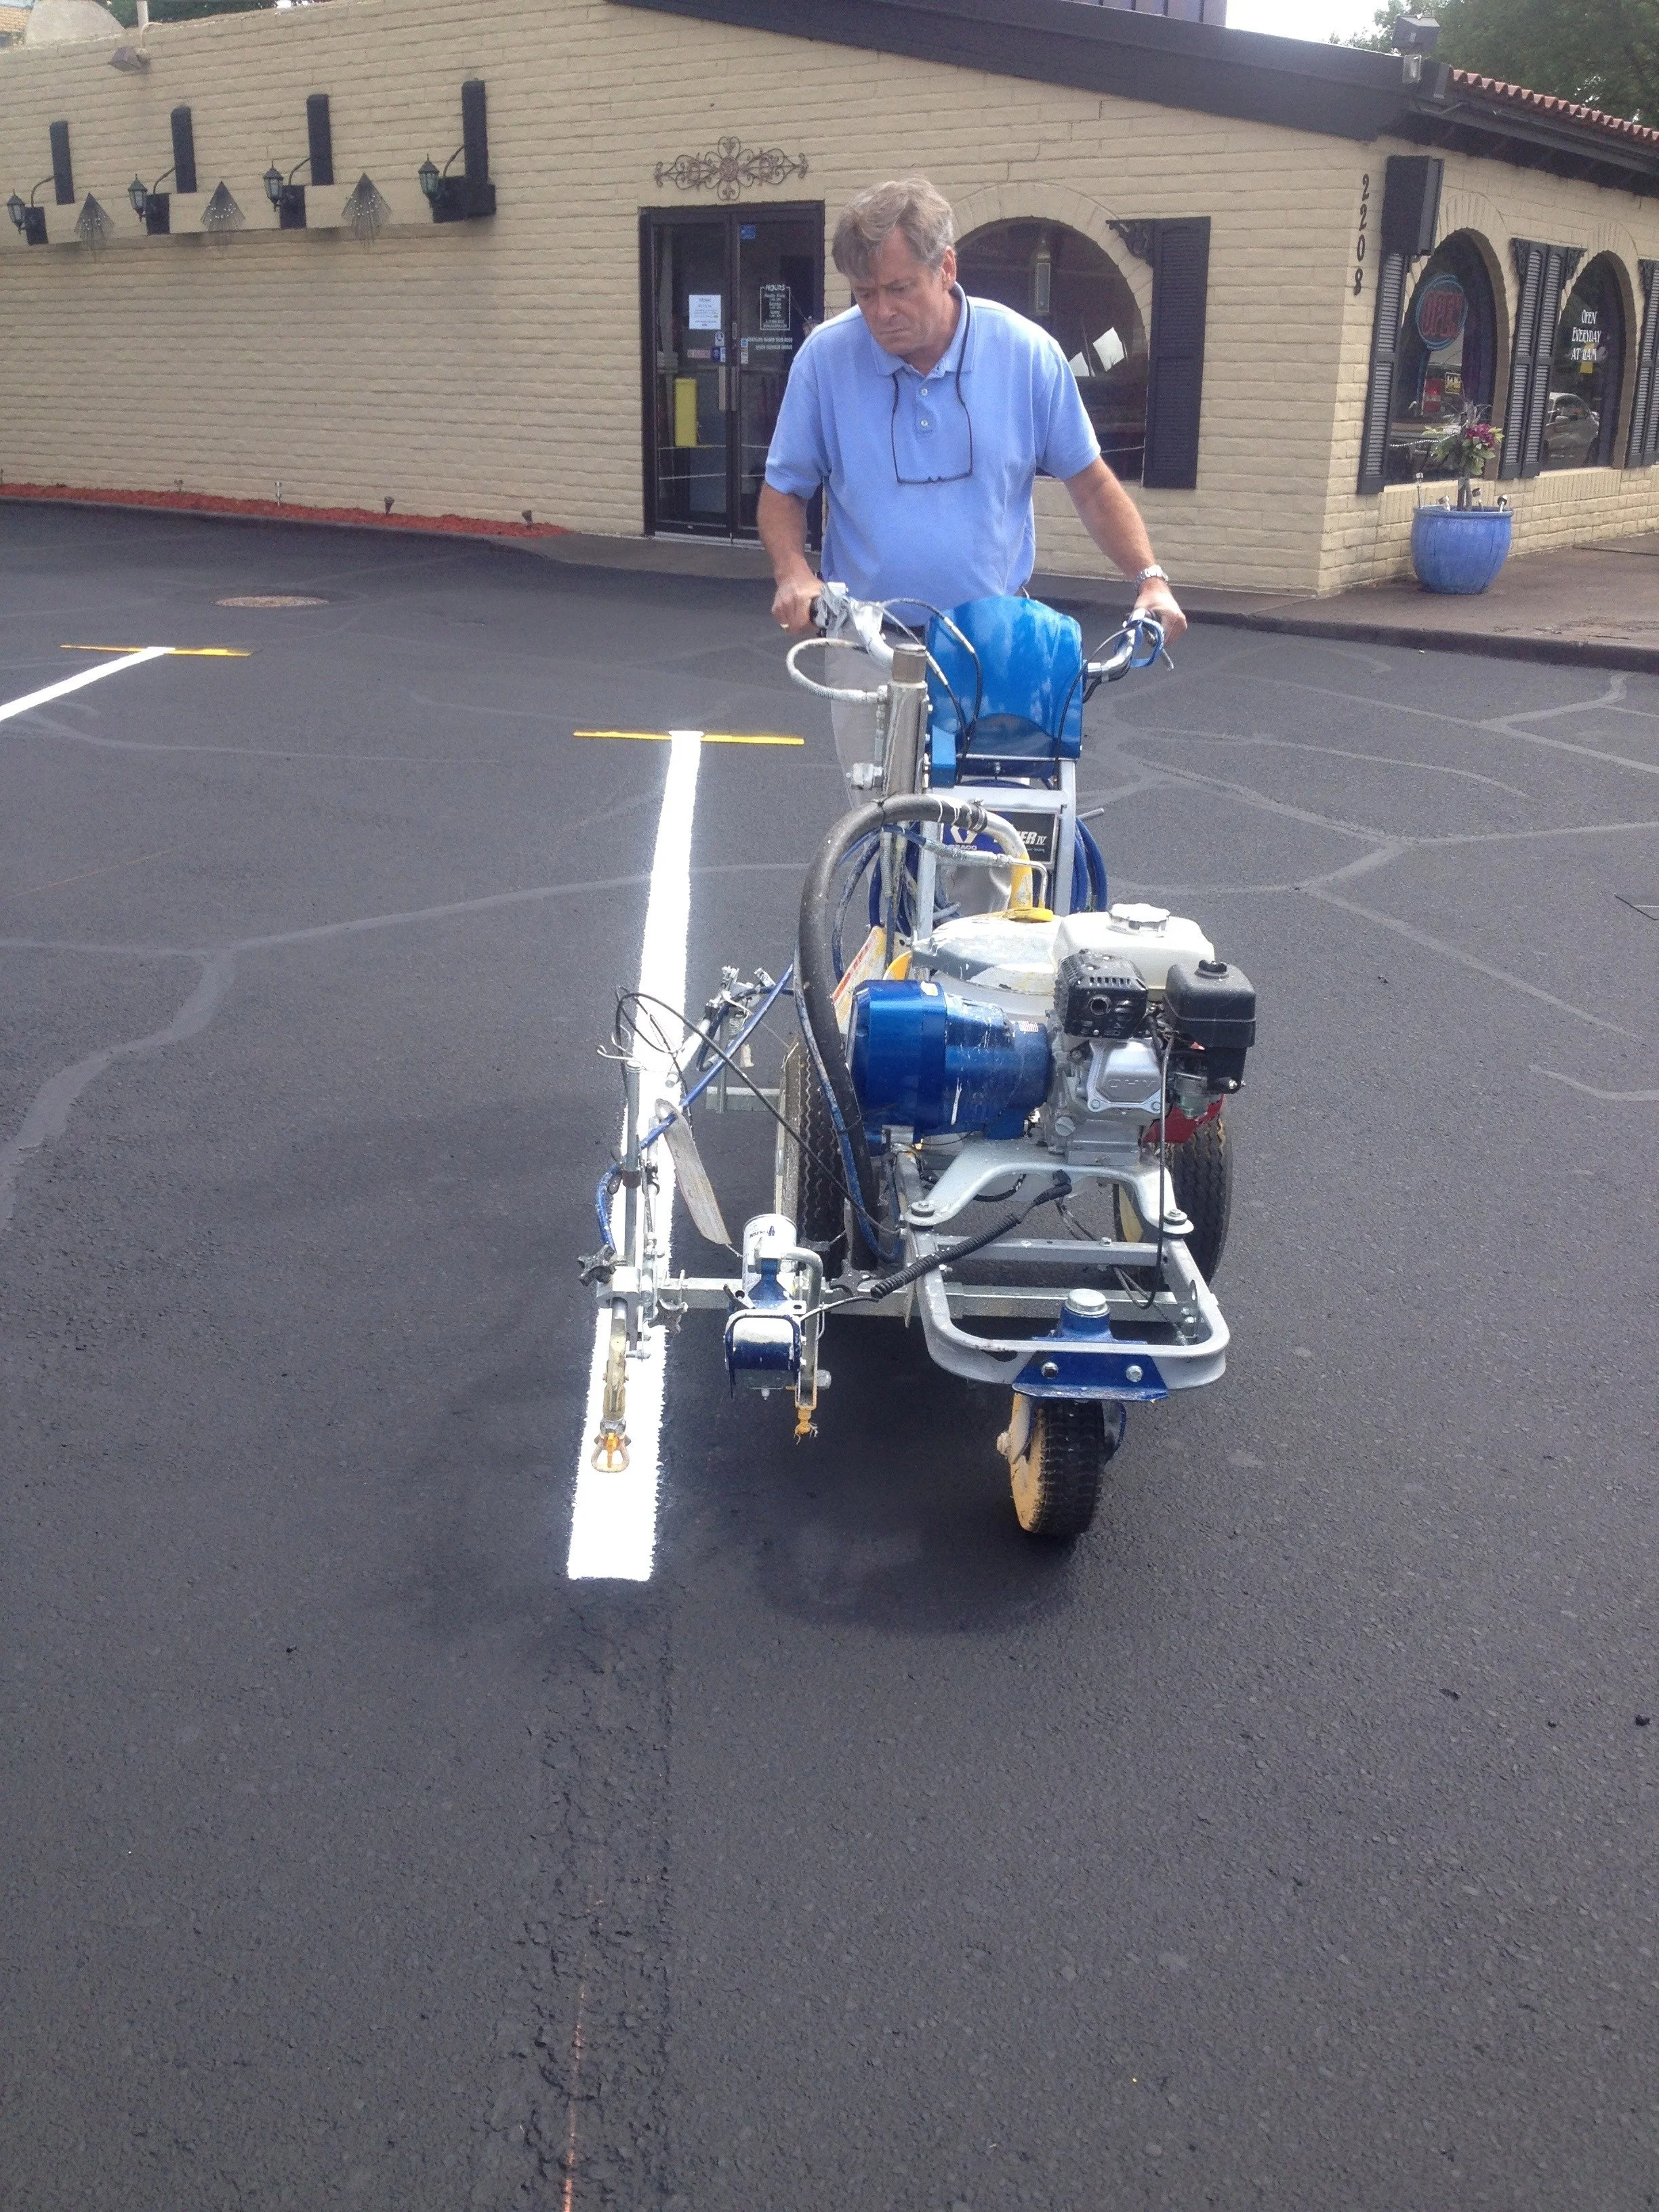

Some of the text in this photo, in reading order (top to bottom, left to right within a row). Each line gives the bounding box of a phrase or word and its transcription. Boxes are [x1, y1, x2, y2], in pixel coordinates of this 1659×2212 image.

[1353, 173, 1370, 296] 2208
[1421, 289, 1464, 339] OPEN
[1581, 309, 1598, 325] OPEN
[1572, 327, 1601, 343] EVERYDAY
[1571, 348, 1581, 361] AT
[1107, 1079, 1155, 1088] OHV
